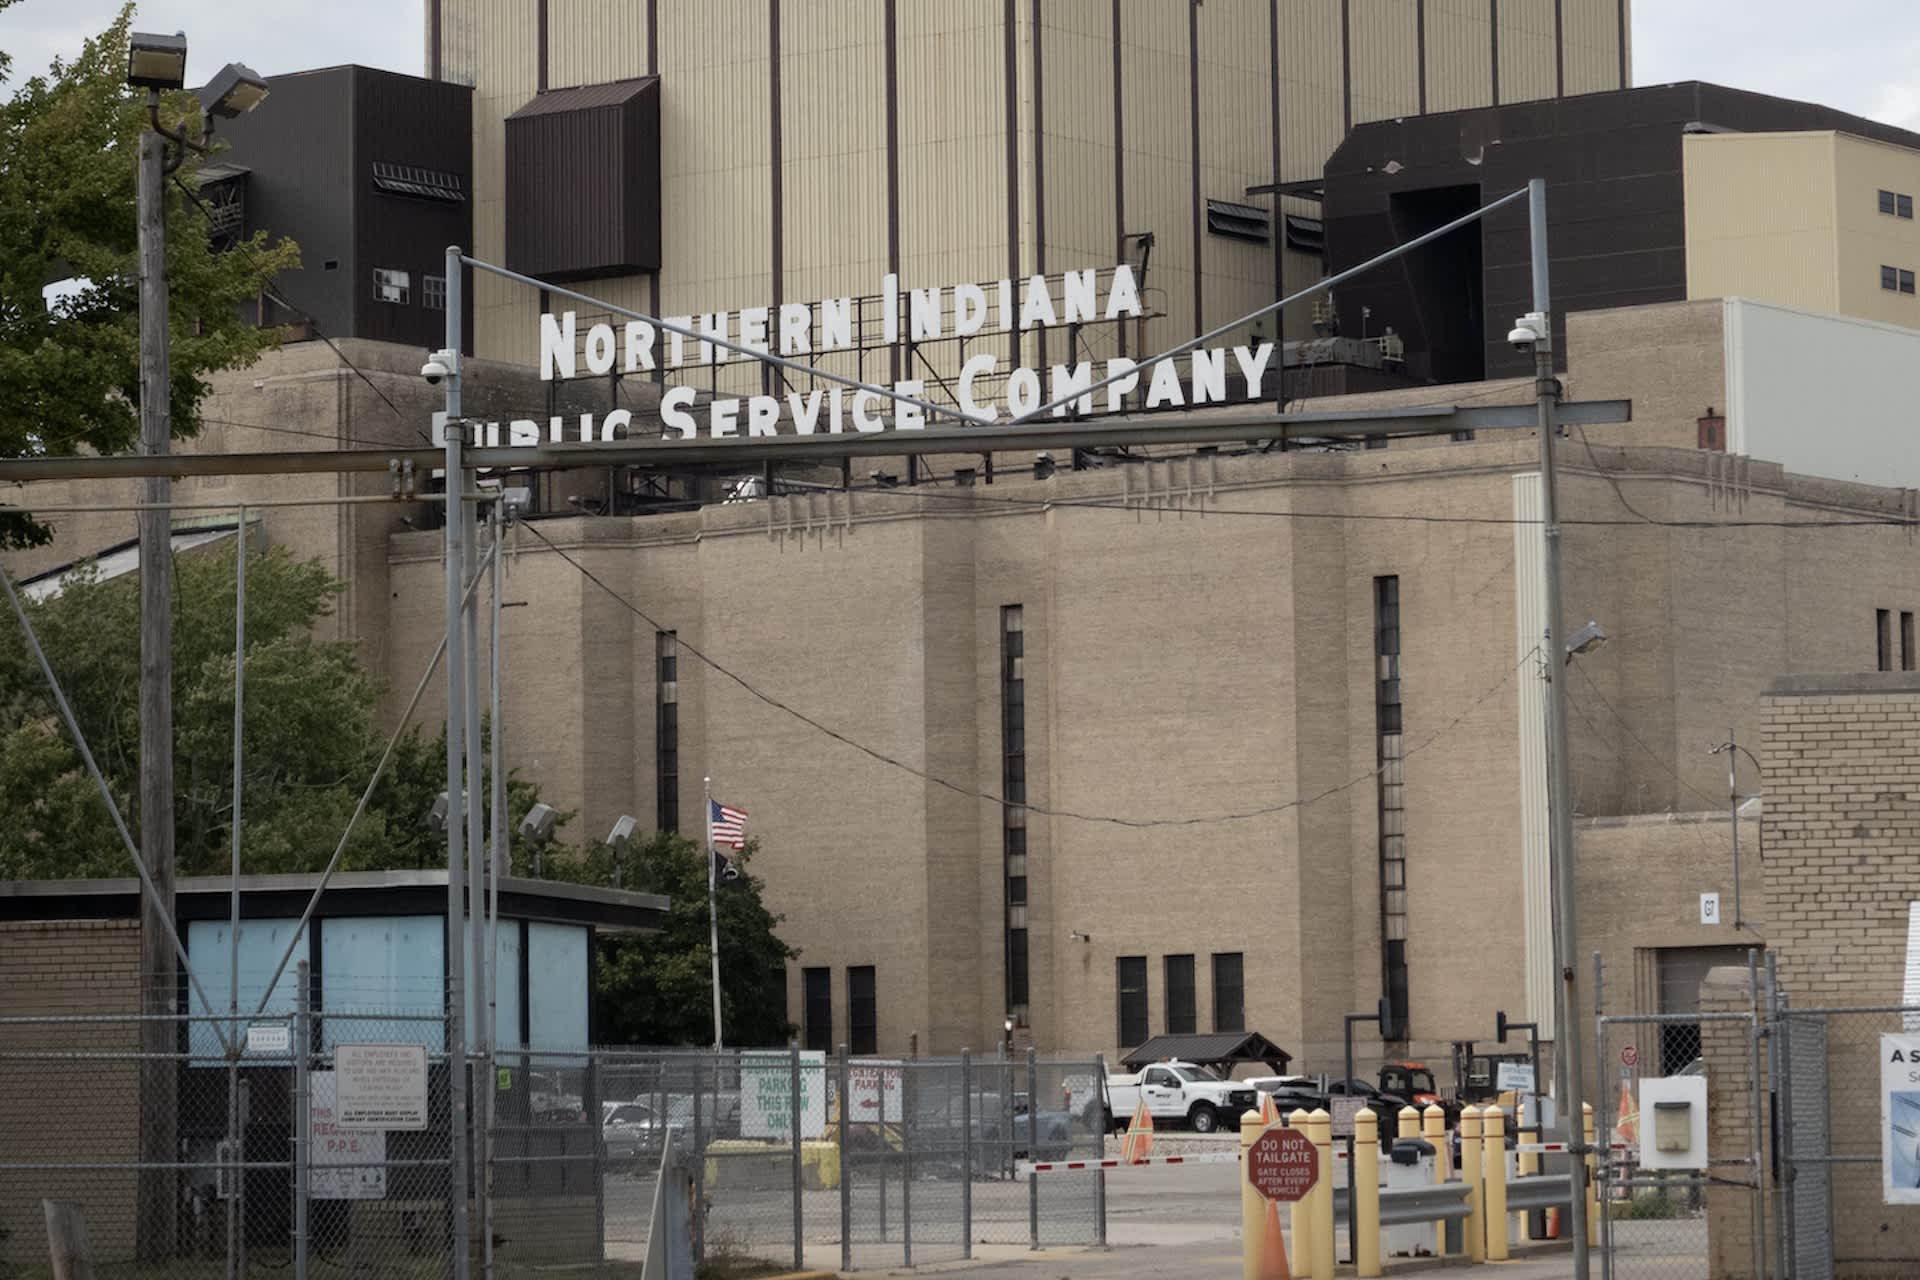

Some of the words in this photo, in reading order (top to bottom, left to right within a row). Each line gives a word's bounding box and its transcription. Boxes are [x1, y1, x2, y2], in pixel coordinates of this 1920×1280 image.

[540, 297, 852, 381] NORTHERN
[883, 264, 1144, 344] INDIANA
[660, 380, 925, 440] SERVICE
[958, 342, 1275, 425] COMPANY
[759, 1078, 807, 1093] PARKG
[855, 1080, 895, 1091] PARKNG
[784, 1096, 809, 1110] RW
[1261, 1140, 1278, 1151] DO
[1282, 1140, 1305, 1151] NOT
[1256, 1152, 1311, 1163] TAILGATE
[1257, 1168, 1277, 1176] GATE
[1280, 1168, 1310, 1176] CLOSES
[1257, 1177, 1283, 1185] AFTER
[1285, 1177, 1310, 1185] EVERY
[1267, 1187, 1300, 1195] VEHICLE
